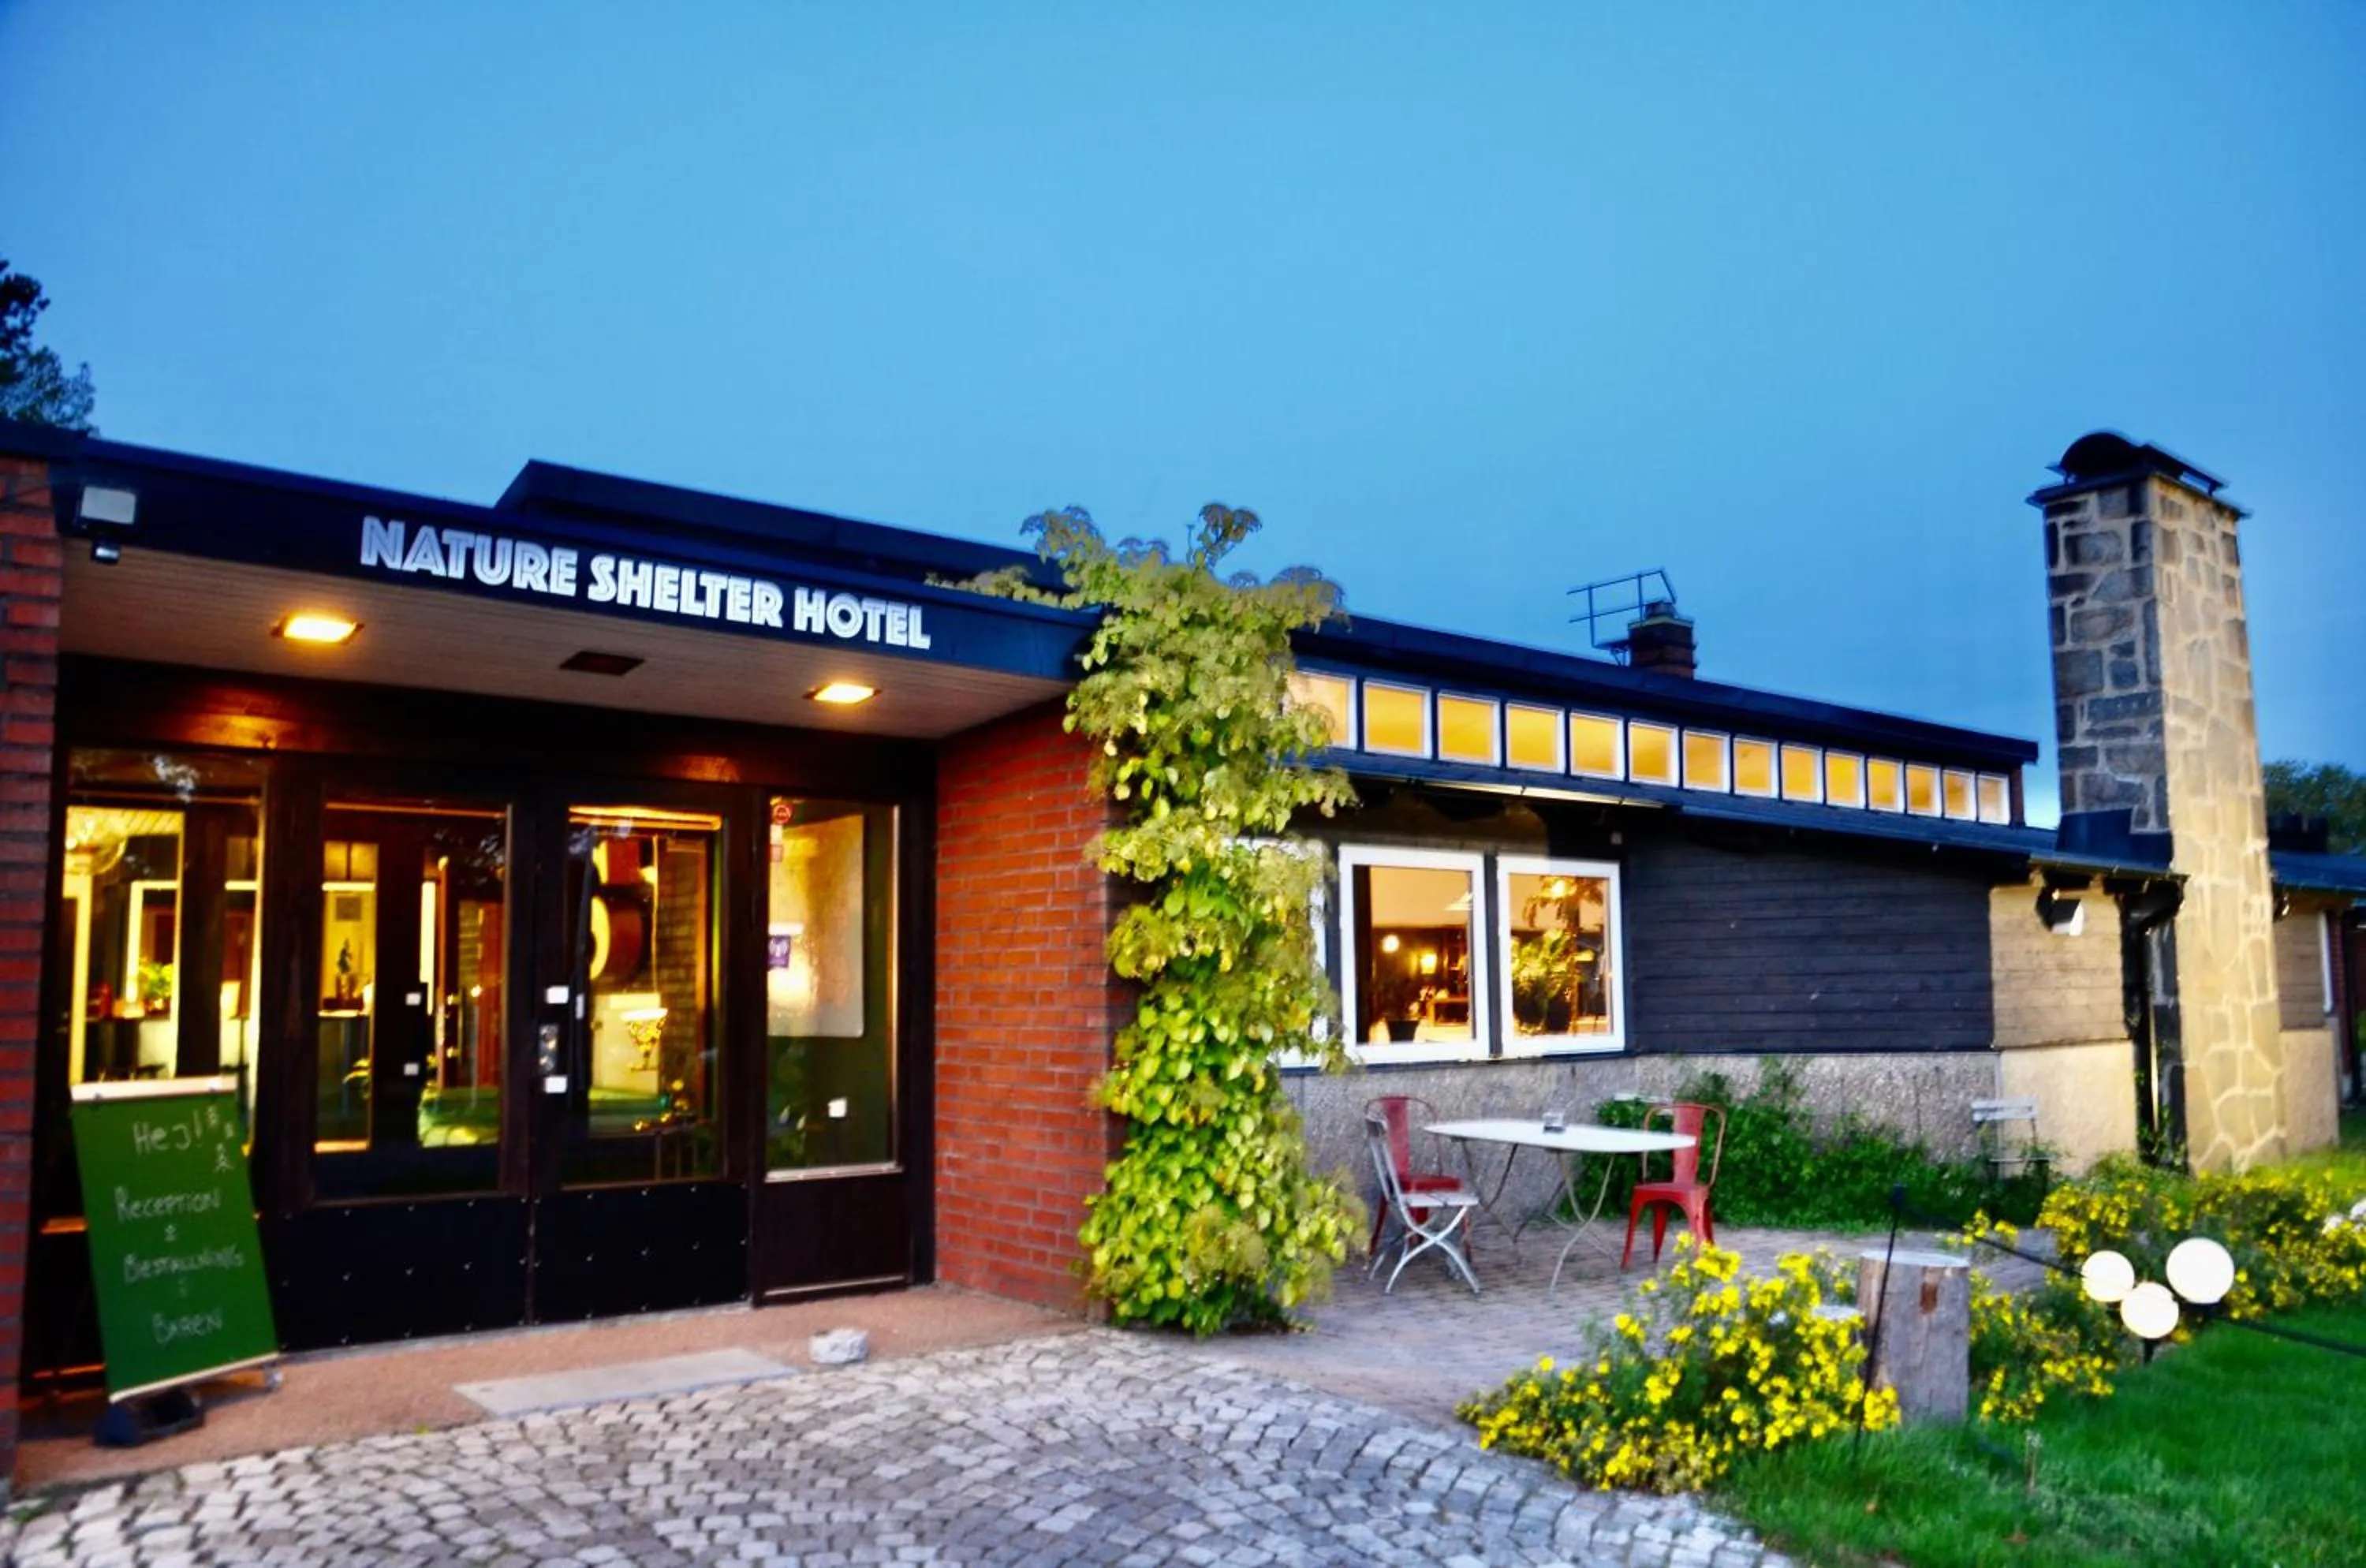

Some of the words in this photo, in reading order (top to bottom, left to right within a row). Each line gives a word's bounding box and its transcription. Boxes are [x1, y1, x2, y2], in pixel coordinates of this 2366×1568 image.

[360, 516, 578, 595] NATURE
[588, 554, 783, 629] SHELTER
[794, 587, 931, 650] HOTEL
